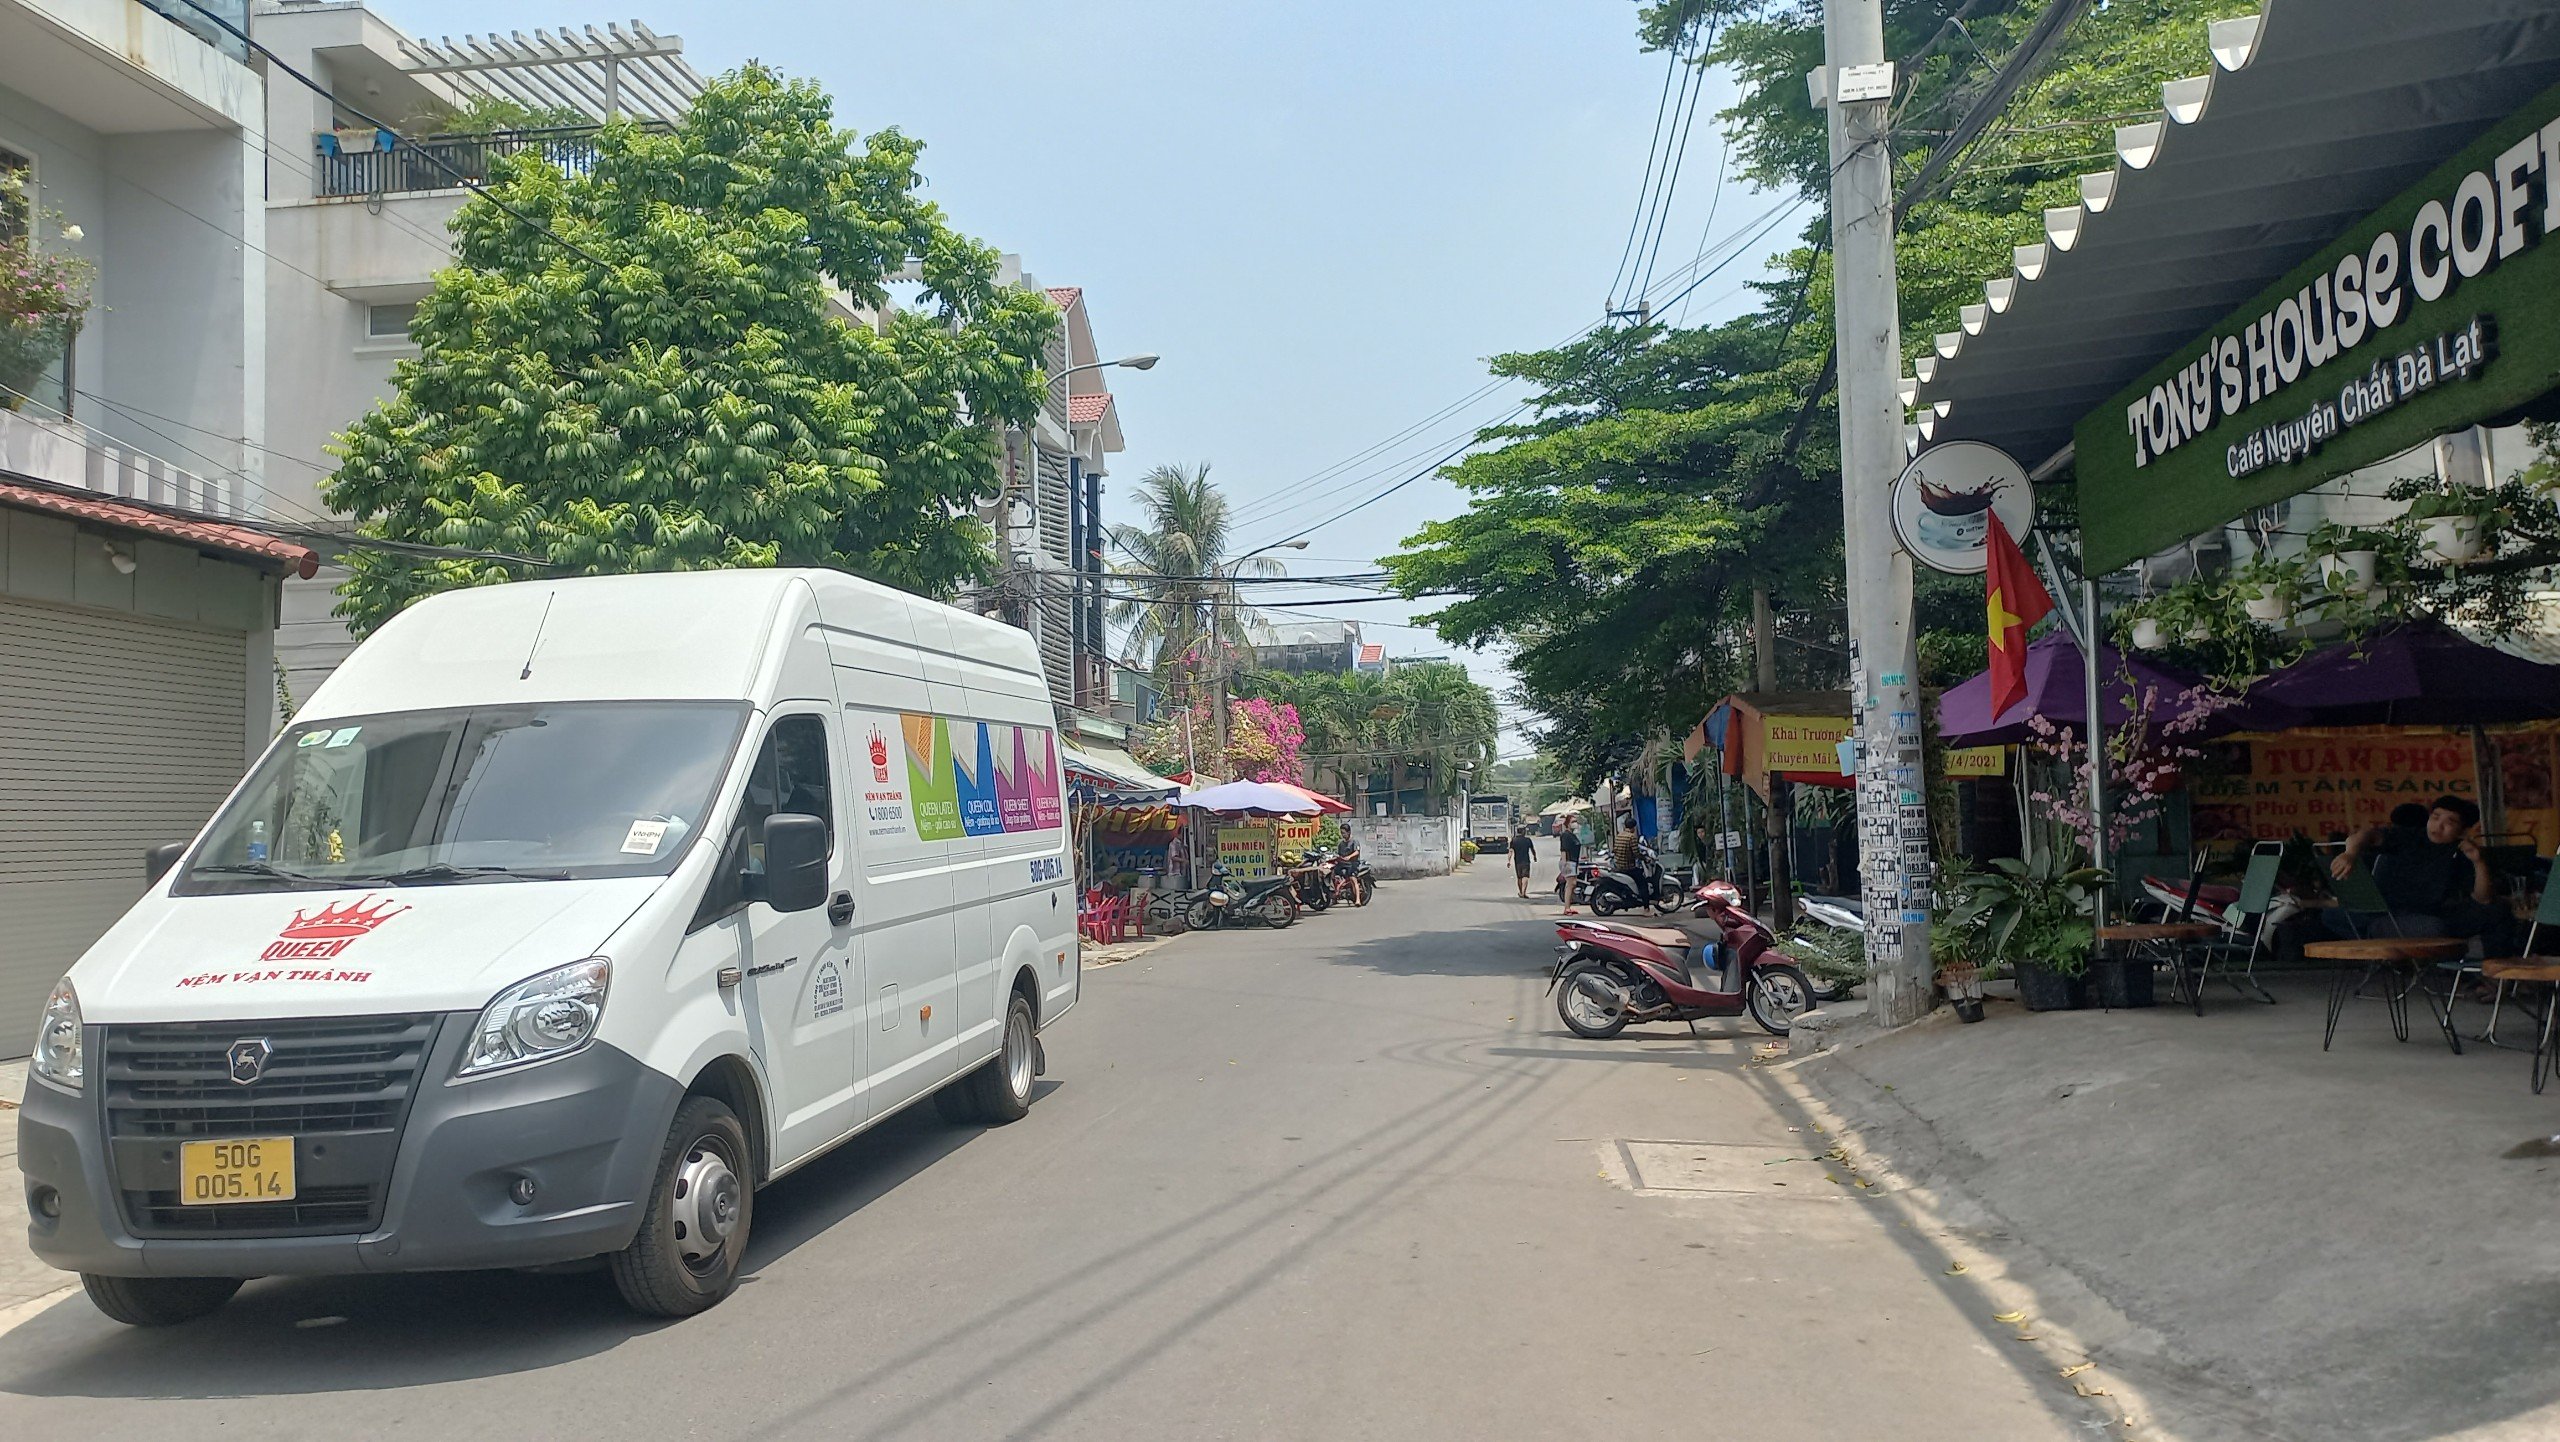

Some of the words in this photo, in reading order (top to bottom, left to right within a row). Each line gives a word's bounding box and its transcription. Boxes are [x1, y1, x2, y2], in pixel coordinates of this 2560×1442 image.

[2226, 428, 2265, 478] Café
[2265, 402, 2336, 464] Nguyên
[2340, 360, 2393, 422] Chất
[2397, 342, 2433, 396] Đà
[2438, 317, 2482, 377] Lạt
[1772, 727, 1797, 740] Khai
[1802, 728, 1841, 743] Trương
[919, 802, 939, 817] QUEEN
[967, 800, 983, 814] QUEEN
[1278, 826, 1310, 839] CƠM
[1221, 840, 1239, 851] BÚN
[1223, 852, 1247, 864] CHÁO
[1235, 868, 1245, 877] TA
[259, 938, 357, 961] QUEEN
[176, 972, 228, 988] NỆM
[233, 970, 284, 984] VẠN
[214, 1143, 261, 1169] 50G
[195, 1171, 282, 1199] 005.14
